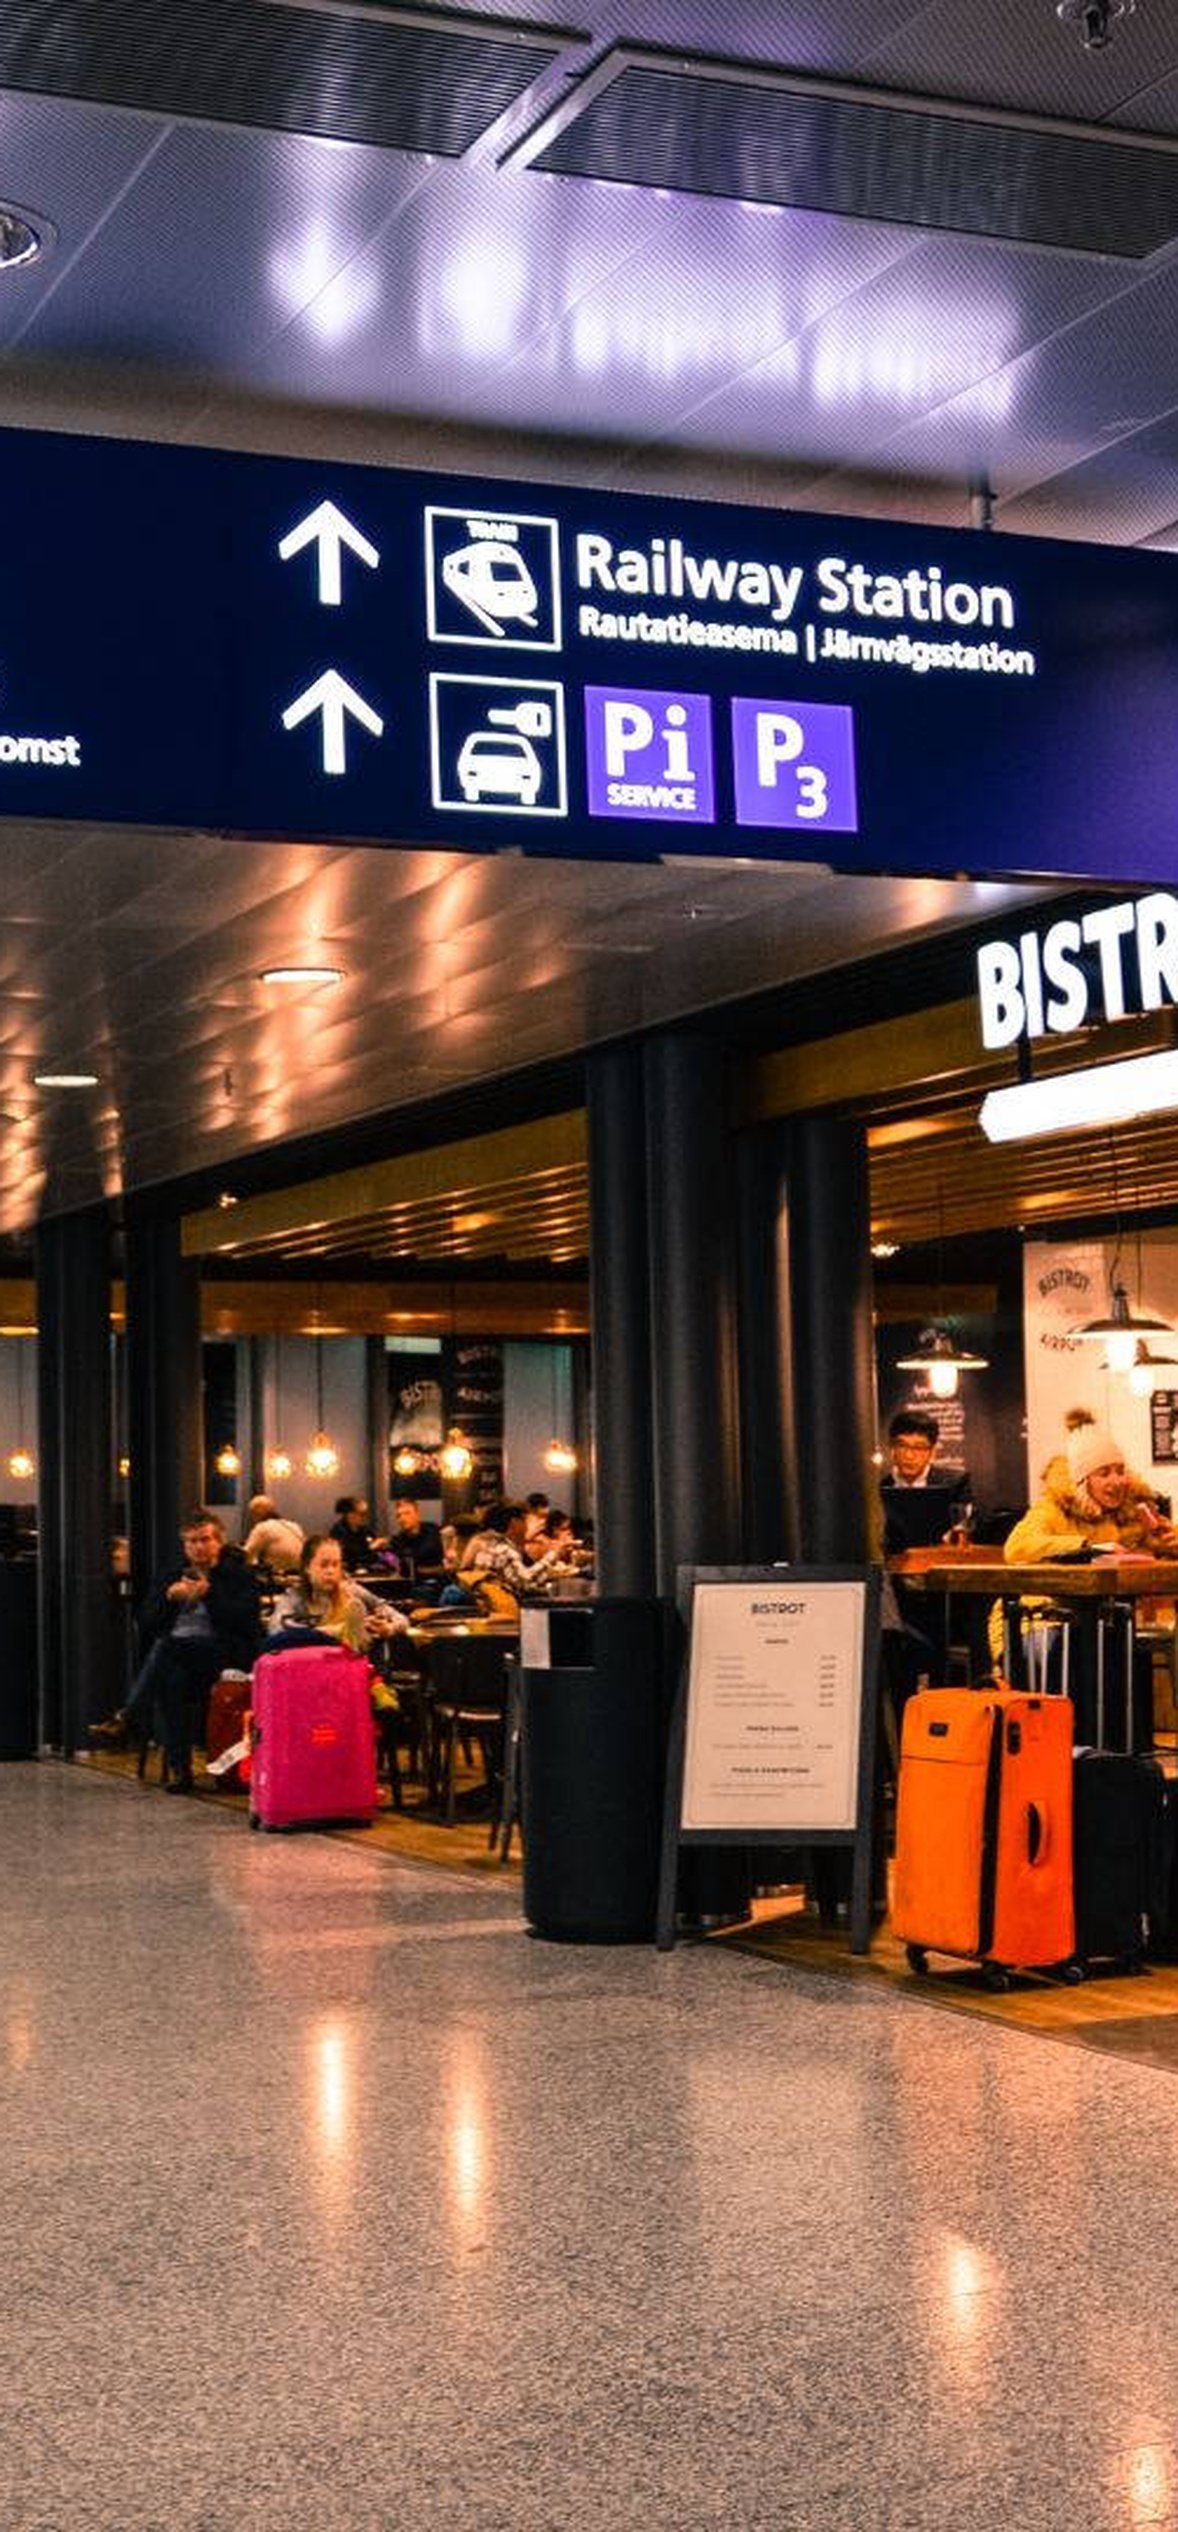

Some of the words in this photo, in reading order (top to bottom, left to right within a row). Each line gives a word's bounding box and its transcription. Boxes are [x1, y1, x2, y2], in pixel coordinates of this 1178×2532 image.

[576, 533, 802, 621] Railway
[817, 557, 1015, 630] Station
[579, 604, 798, 655] Rautatieasema
[820, 627, 1035, 675] Järnvägsstation
[604, 700, 696, 781] Pi
[606, 782, 697, 811] SERVICE
[978, 893, 1178, 1048] BISTR
[751, 1603, 806, 1614] BISTROT
